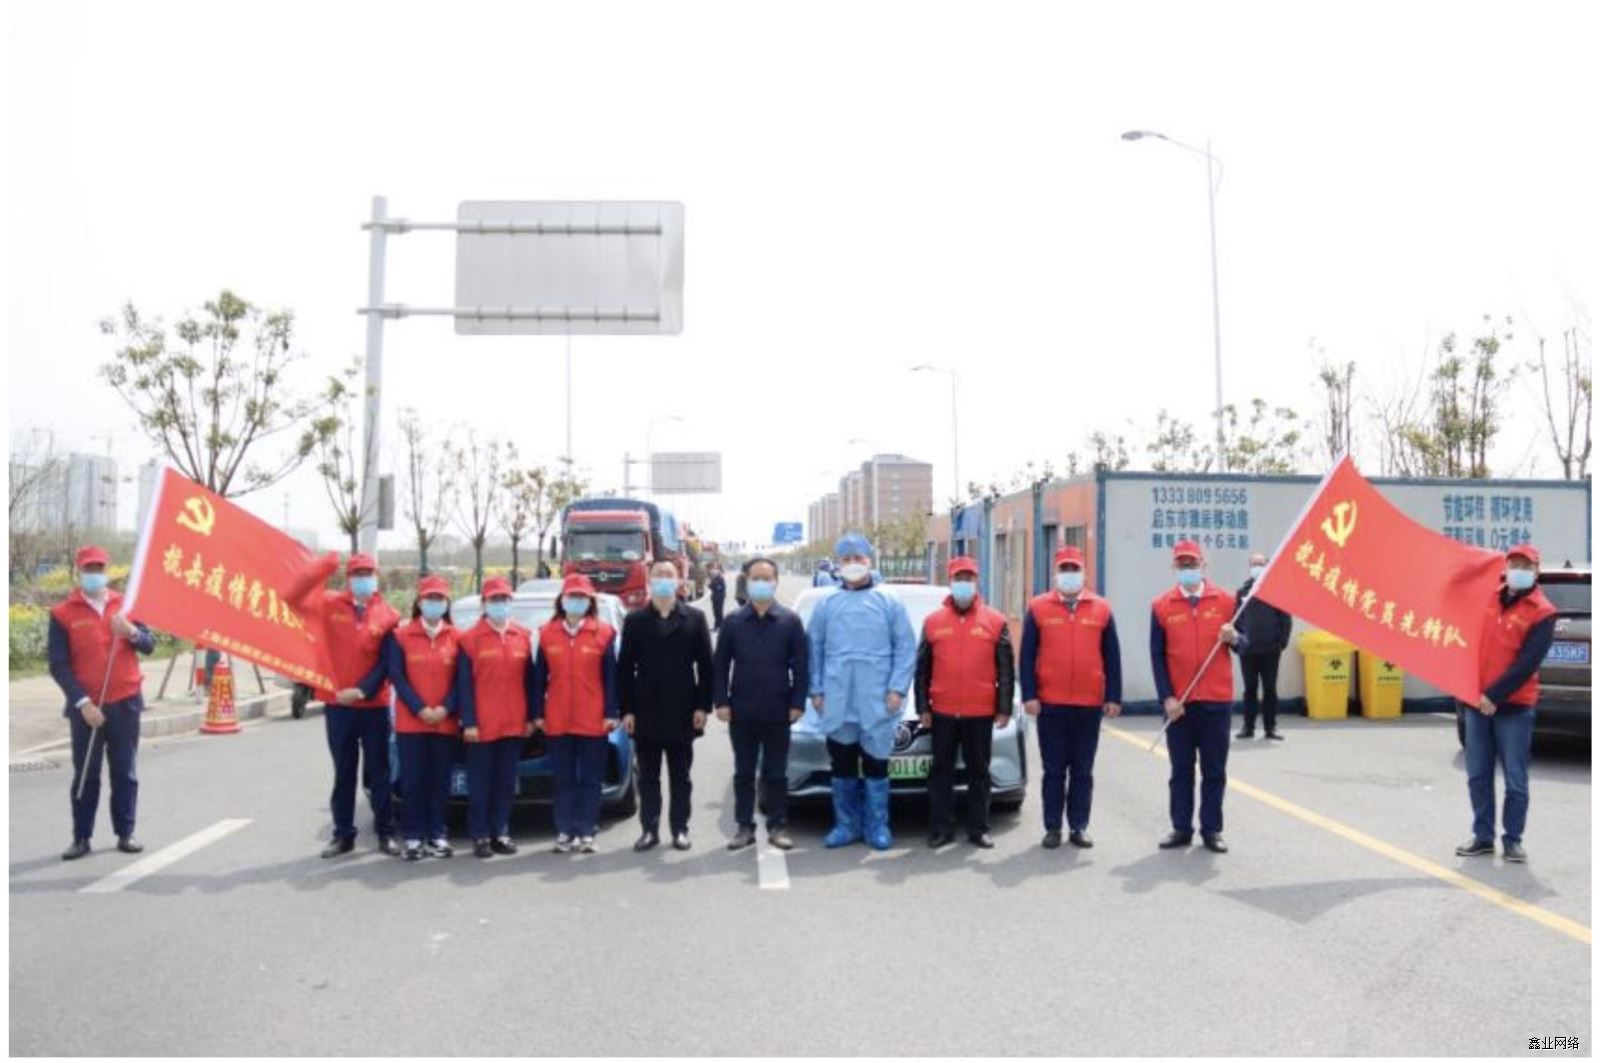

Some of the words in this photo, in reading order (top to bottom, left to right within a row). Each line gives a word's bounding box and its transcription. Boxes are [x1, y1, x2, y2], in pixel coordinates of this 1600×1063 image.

[1152, 487, 1184, 504] 1333
[1187, 487, 1211, 504] 809
[1215, 487, 1248, 505] 5656
[1295, 541, 1468, 648] 抗击疫情党员先锋队
